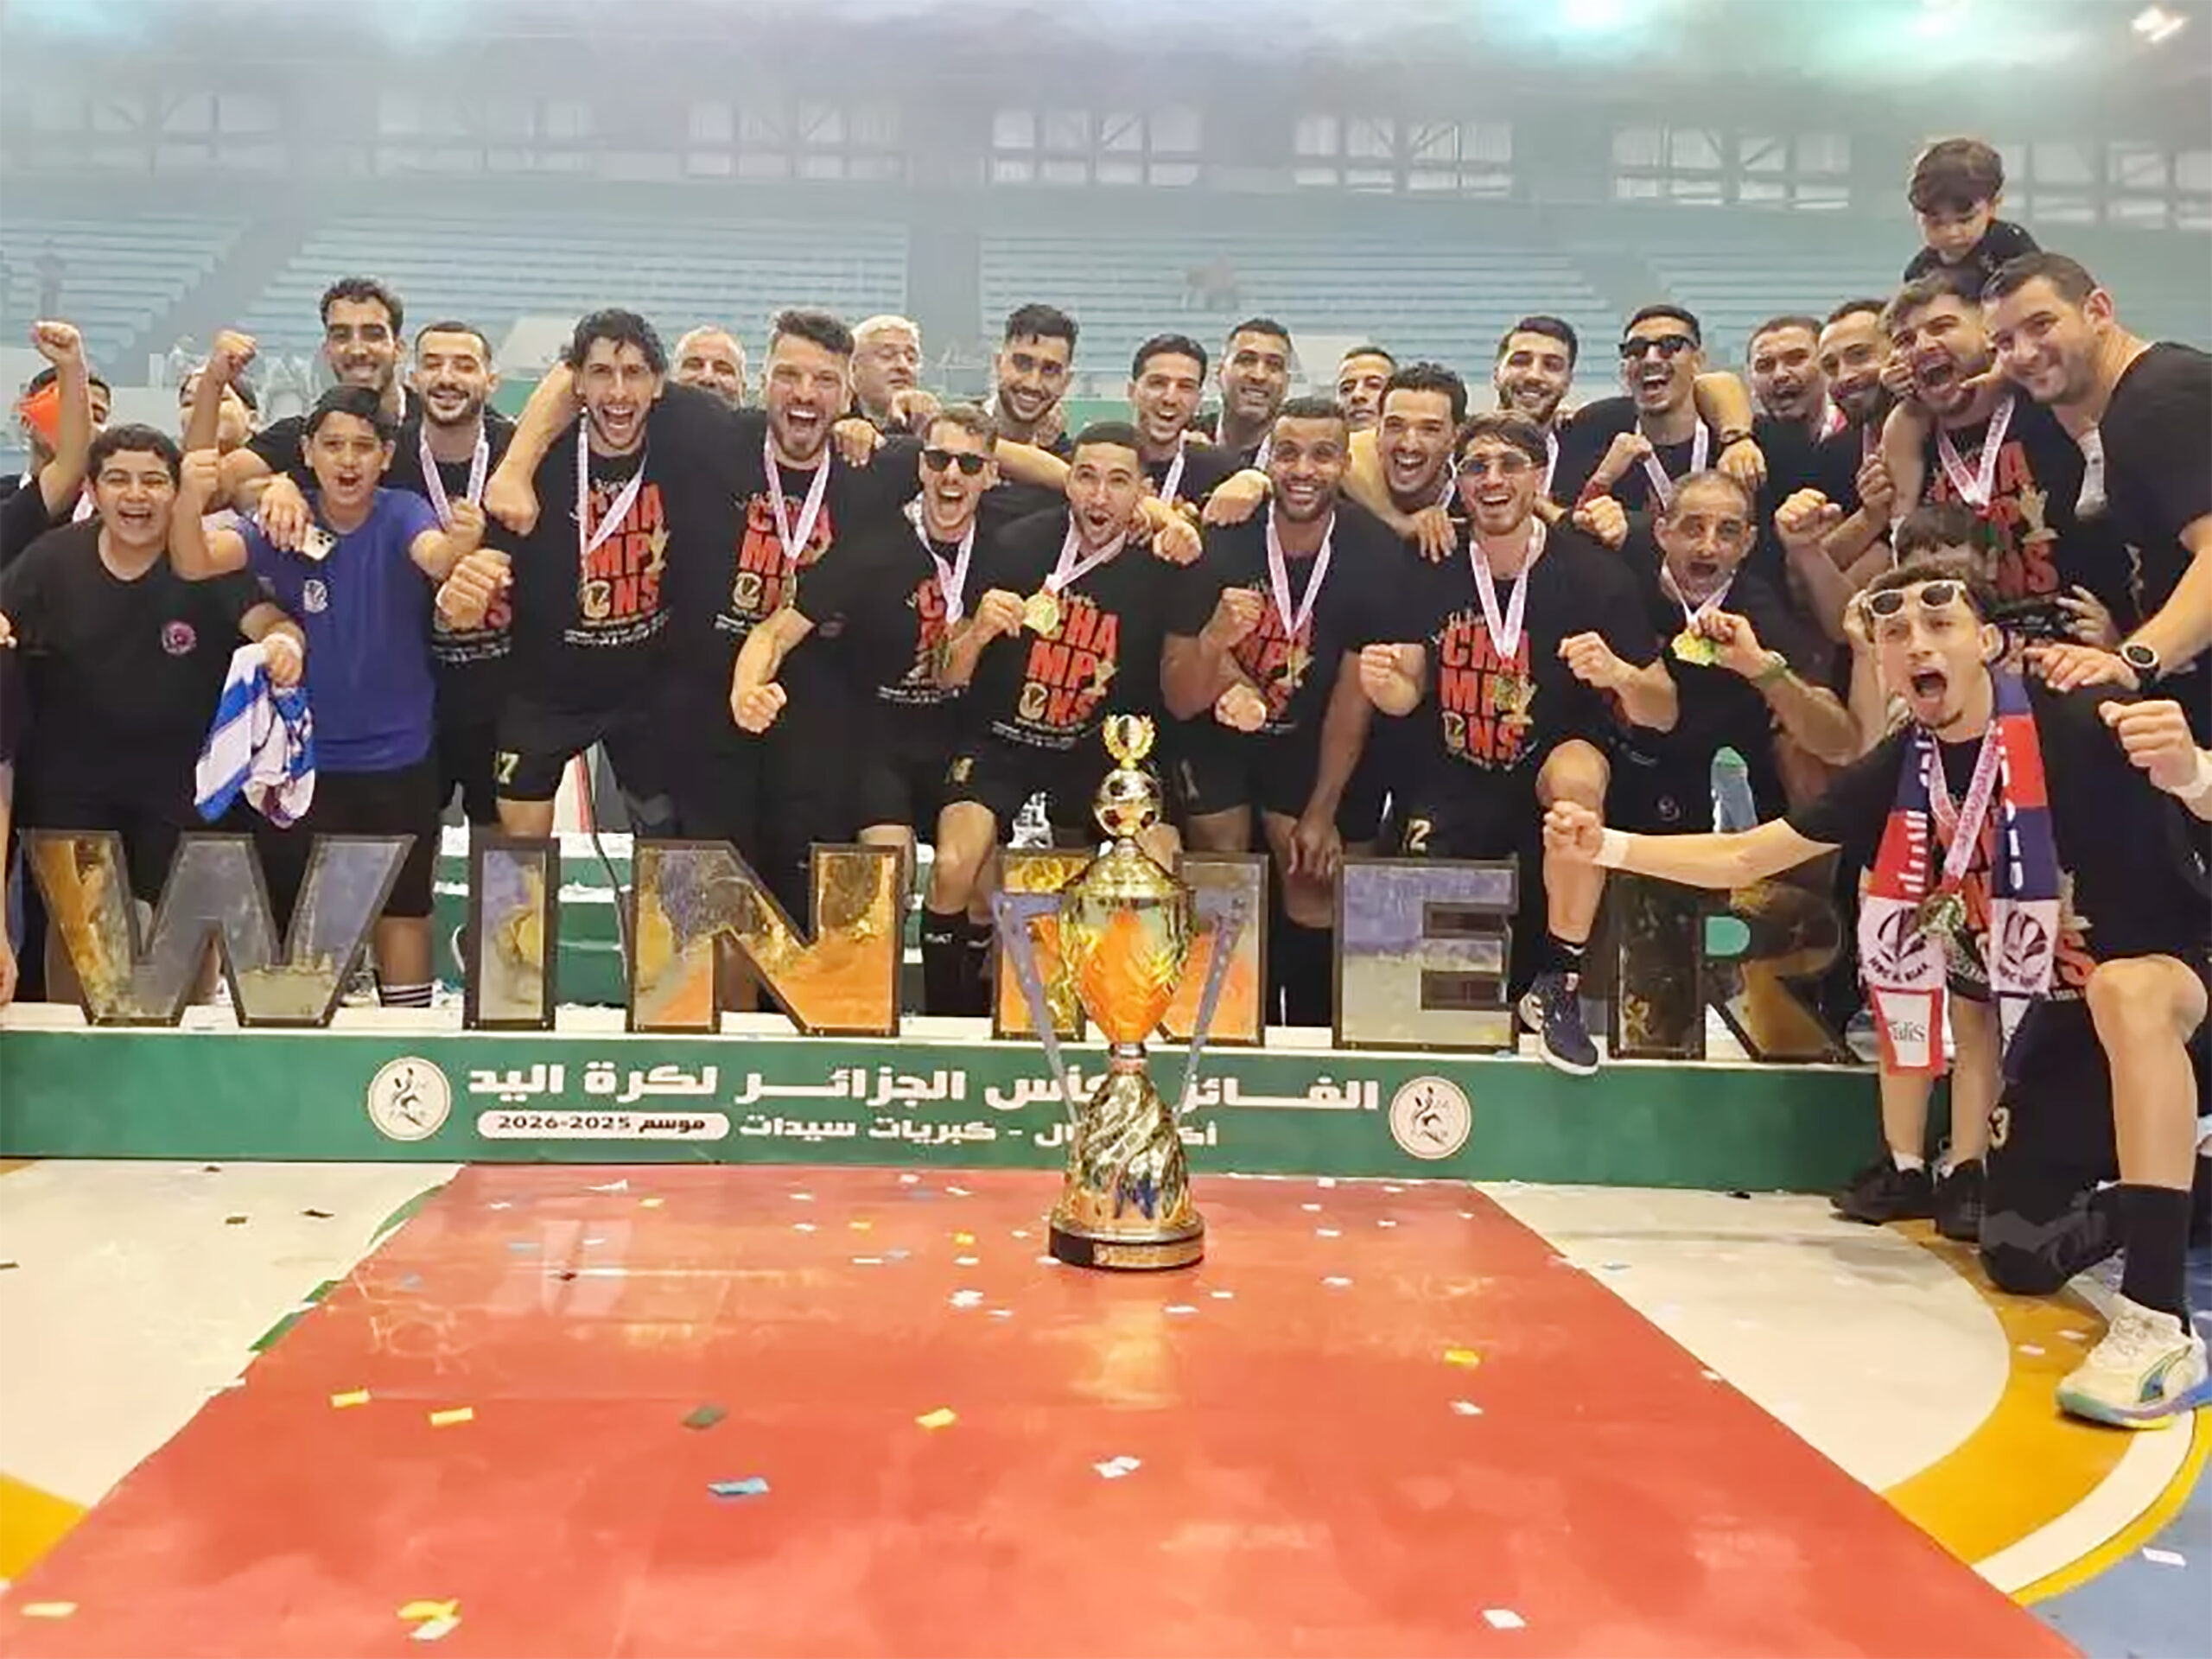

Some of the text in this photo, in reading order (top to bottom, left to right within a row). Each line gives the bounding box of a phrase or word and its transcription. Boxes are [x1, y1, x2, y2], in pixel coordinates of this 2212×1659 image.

[468, 1064, 565, 1102] اليد
[583, 1061, 718, 1103] لكرة
[639, 1118, 706, 1134] موسم
[739, 1116, 856, 1141] سيدات
